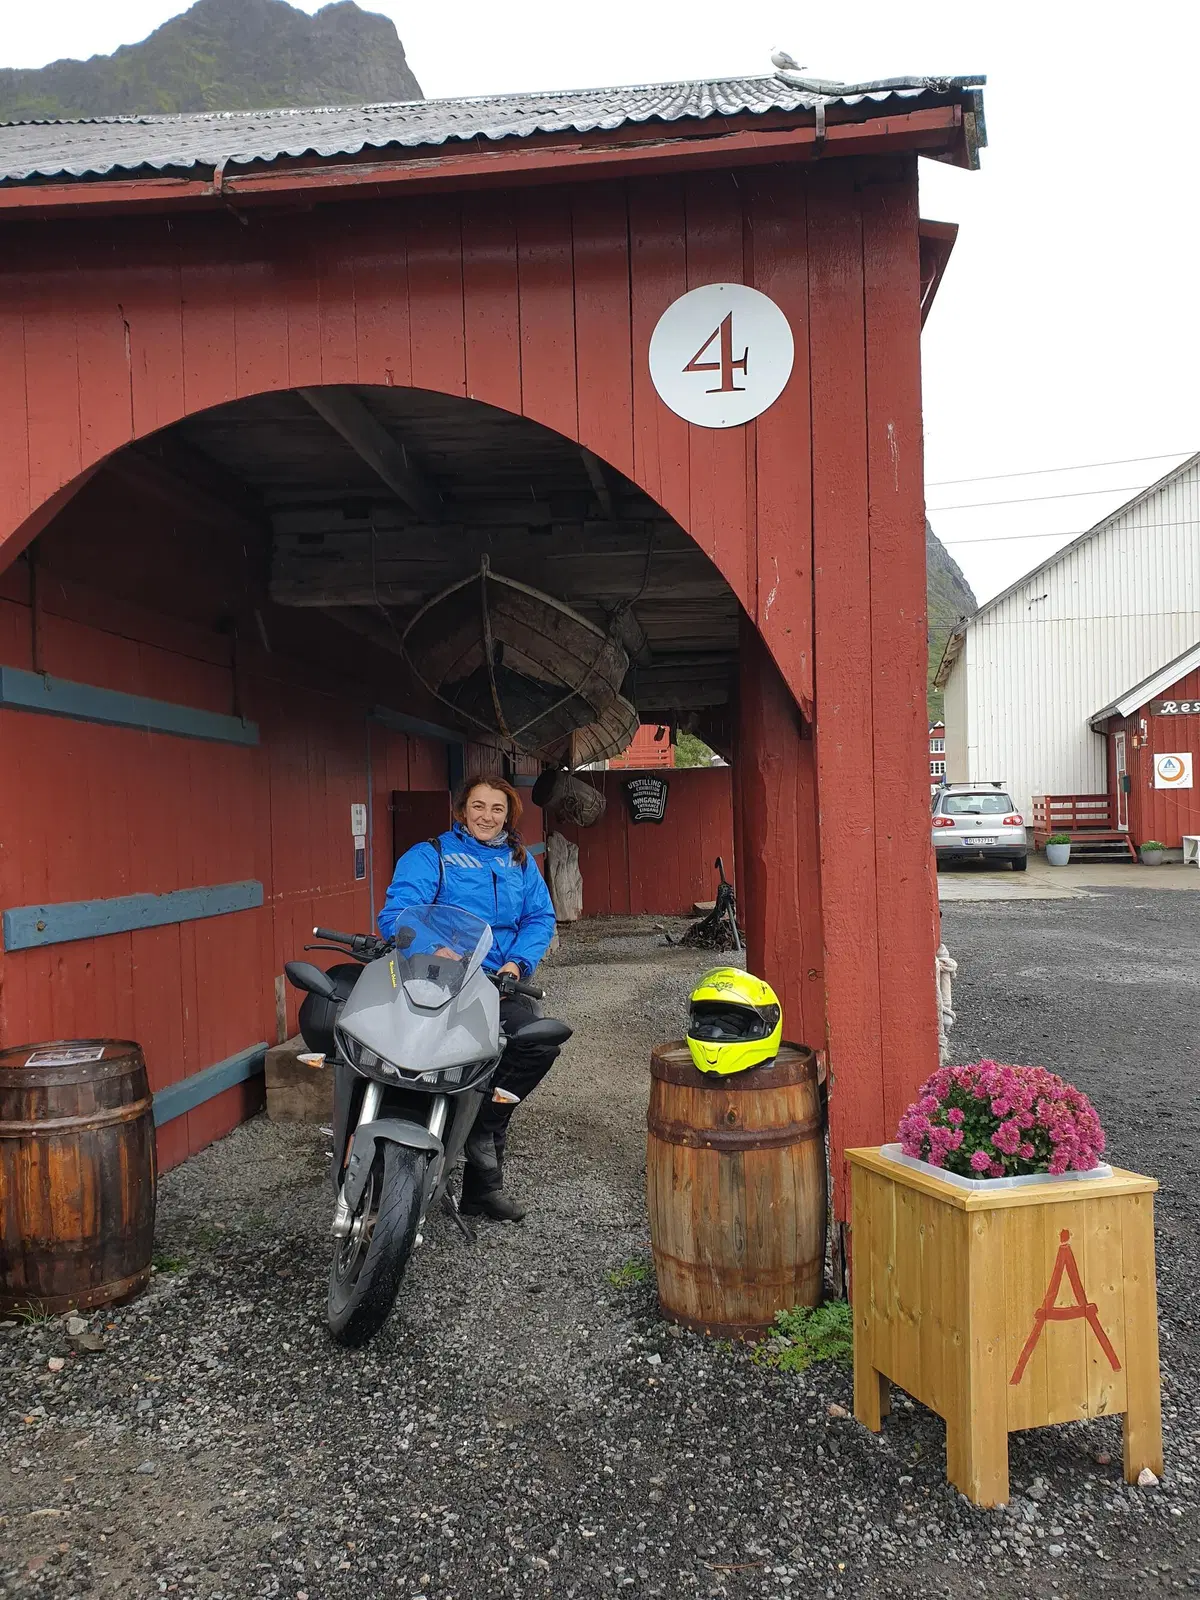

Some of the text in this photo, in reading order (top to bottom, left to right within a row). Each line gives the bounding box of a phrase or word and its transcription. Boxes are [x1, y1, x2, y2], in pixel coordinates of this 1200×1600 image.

[682, 310, 748, 393] 4
[628, 779, 662, 789] UTSTILLING
[633, 797, 661, 805] INNGANG
